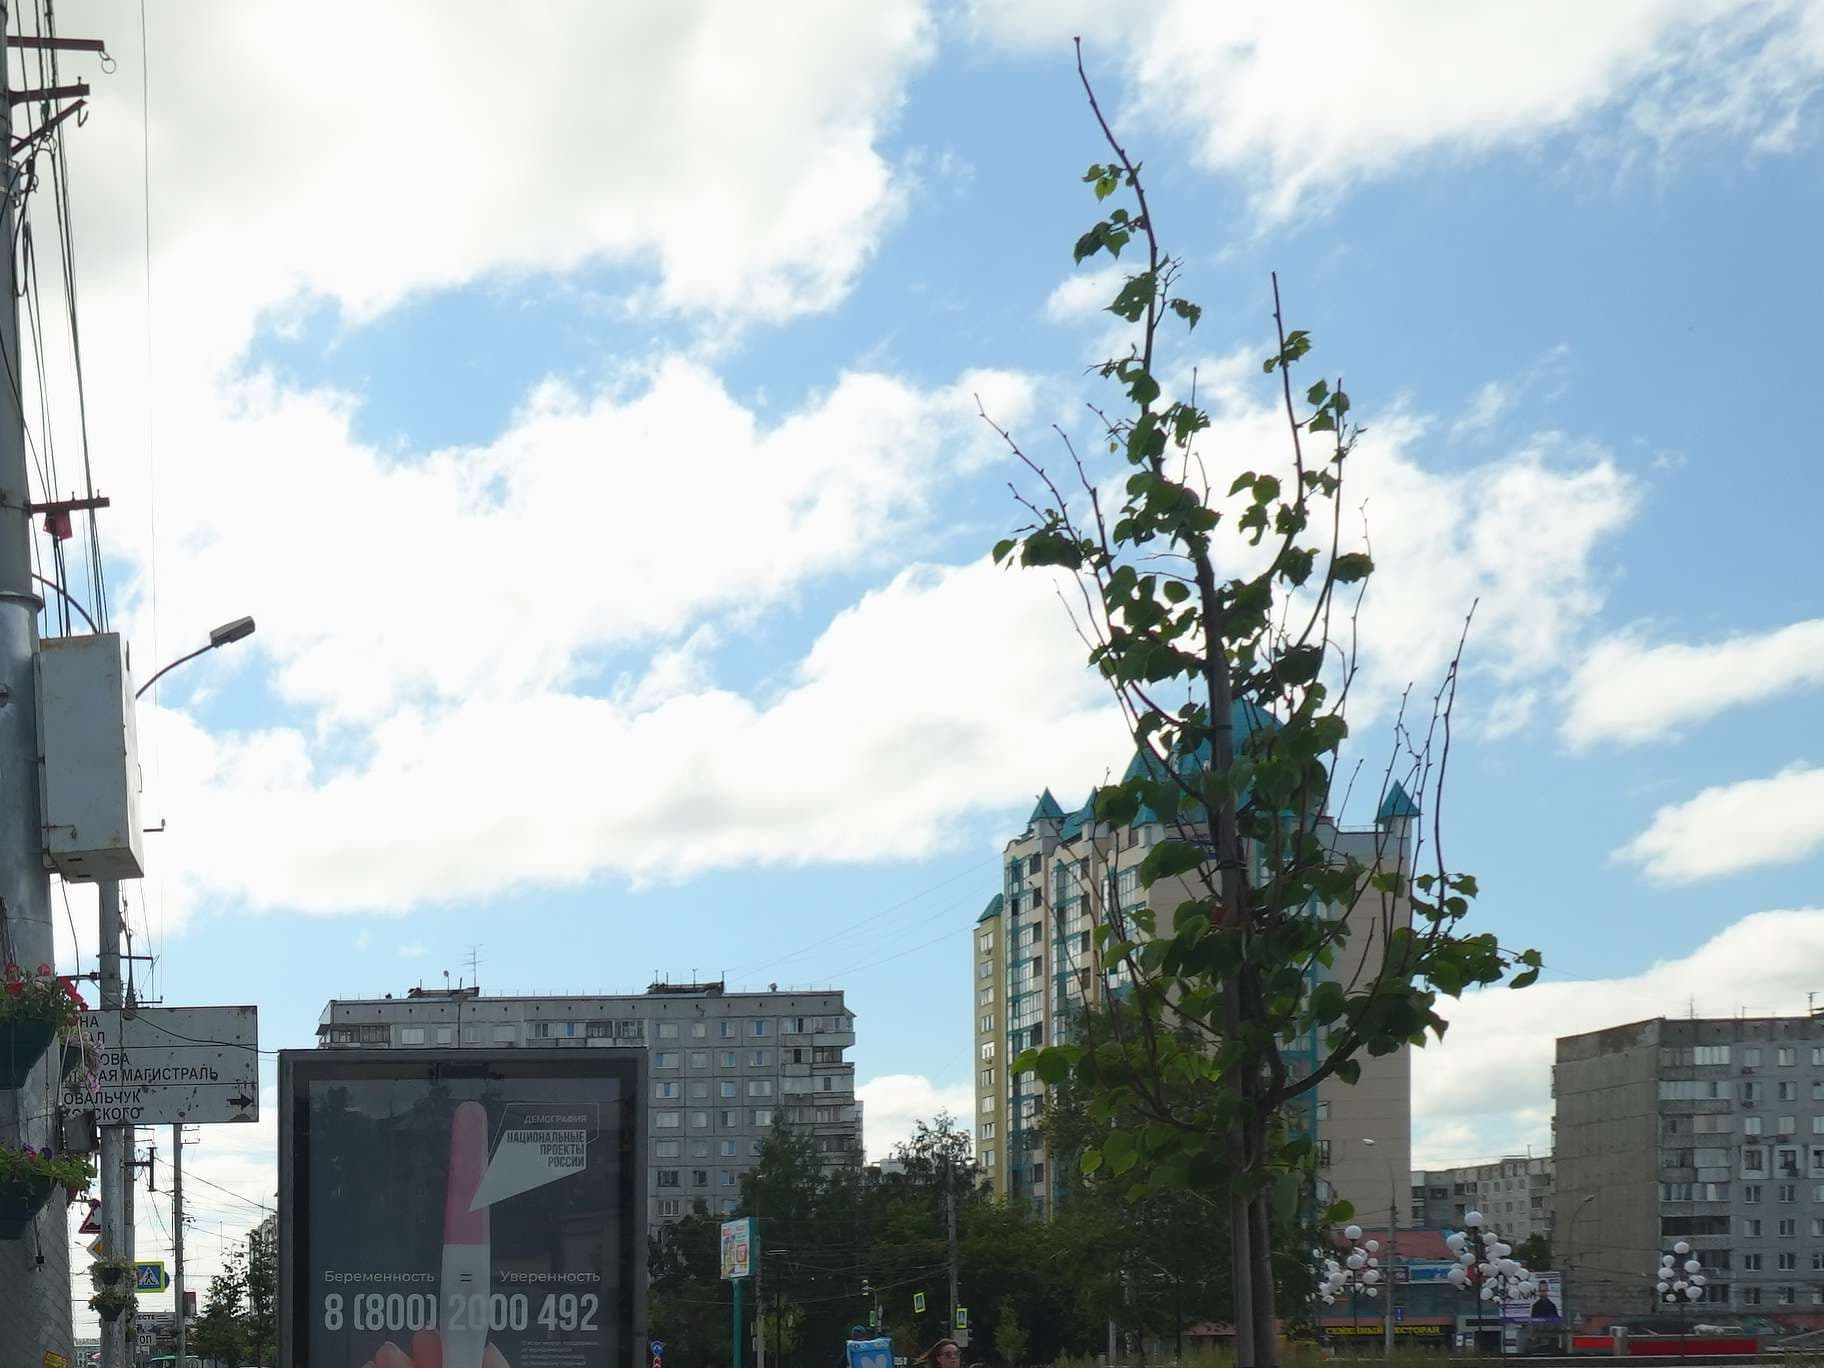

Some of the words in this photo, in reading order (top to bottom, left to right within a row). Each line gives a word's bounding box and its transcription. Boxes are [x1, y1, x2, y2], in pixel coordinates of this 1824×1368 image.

[122, 1066, 219, 1081] МАГИСТРАЛЬ
[64, 1090, 142, 1105] ОВАЛЬЧУК
[524, 1114, 587, 1125] ДЕМОГРАФИЯ
[507, 1131, 585, 1143] НАЦИОНАЛЬНЫЕ
[540, 1144, 584, 1155] ПРОЕКТЫ
[548, 1156, 584, 1167] РОССИИ
[325, 1270, 435, 1283] Беременность
[500, 1270, 601, 1283] Уверенность
[324, 1293, 344, 1331] 8
[353, 1293, 437, 1331] (800)
[447, 1293, 528, 1331] 2000
[537, 1293, 599, 1331] 492
[1394, 1326, 1440, 1334] ЕСТОРАН
